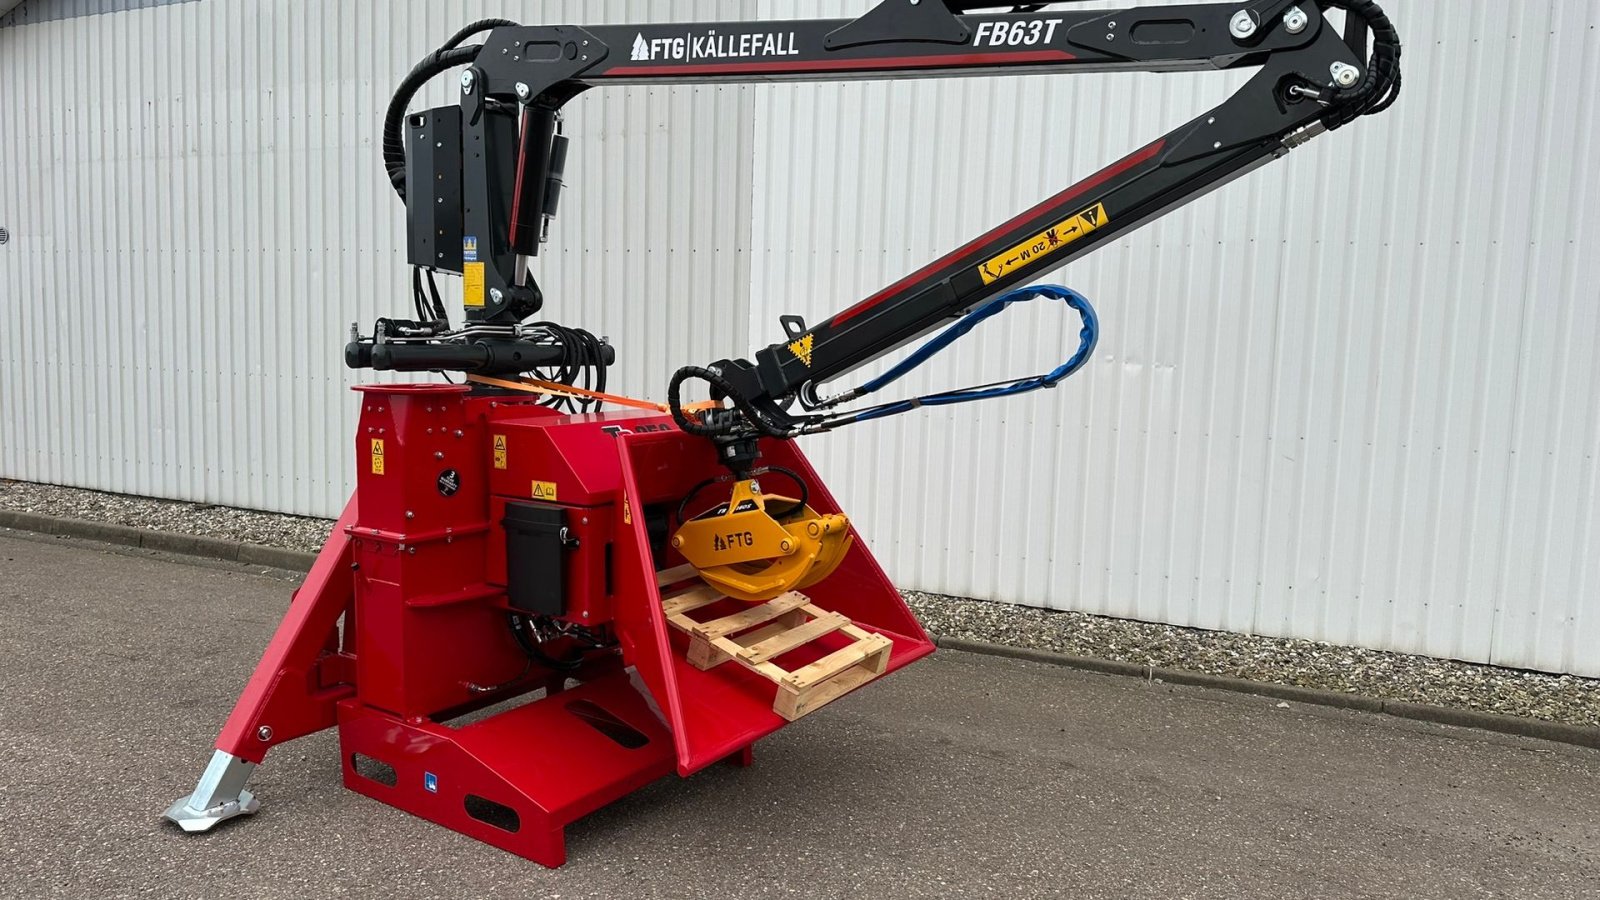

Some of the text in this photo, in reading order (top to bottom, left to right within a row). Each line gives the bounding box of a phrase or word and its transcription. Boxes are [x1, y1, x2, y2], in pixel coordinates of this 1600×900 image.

[650, 30, 799, 60] FTG KÄLLEFALL
[973, 19, 1063, 47] FB63T
[1020, 241, 1046, 261] 20 M
[726, 531, 754, 549] FTG
